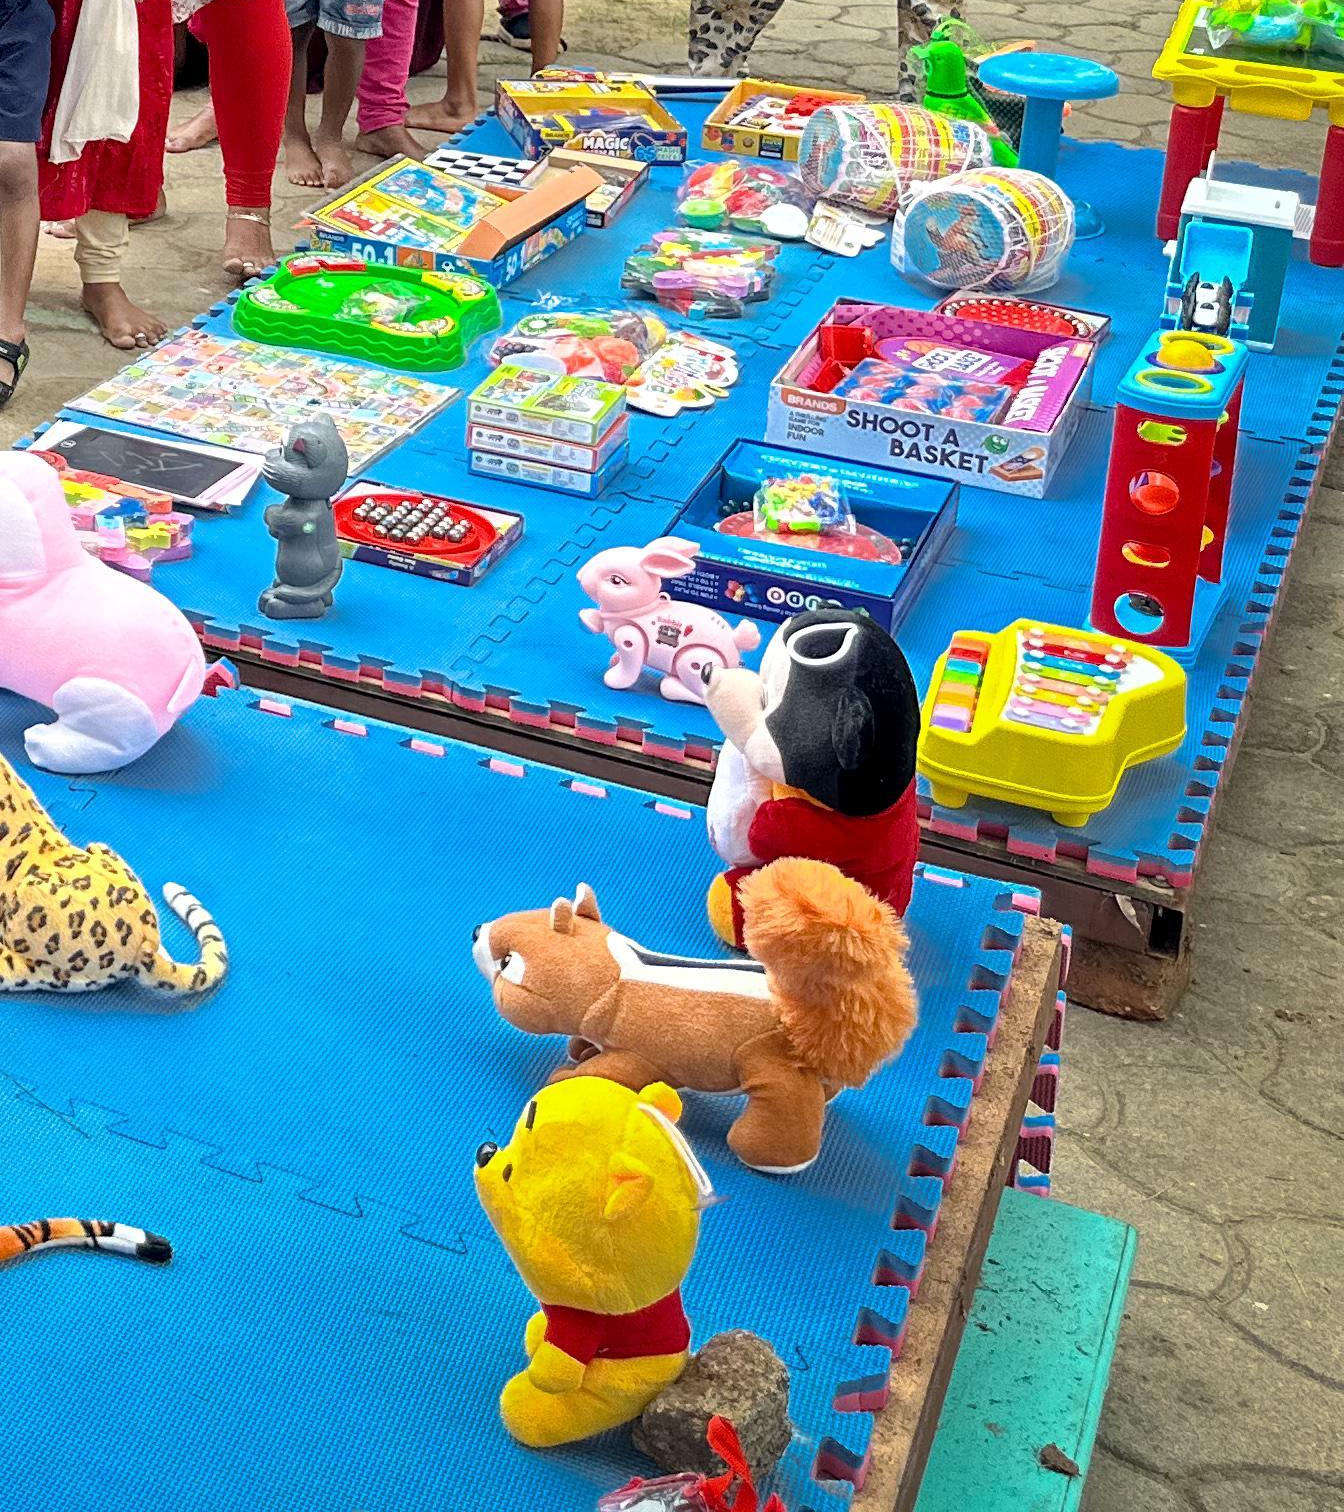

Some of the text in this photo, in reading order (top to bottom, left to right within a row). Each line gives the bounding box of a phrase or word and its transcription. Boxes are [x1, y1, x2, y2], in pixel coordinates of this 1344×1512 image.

[583, 134, 630, 151] MAGIC
[787, 393, 838, 413] BRANDS
[787, 431, 807, 442] FUN
[788, 423, 825, 437] INDOOR
[846, 409, 960, 448] SHOOT A
[890, 438, 989, 474] BASKET
